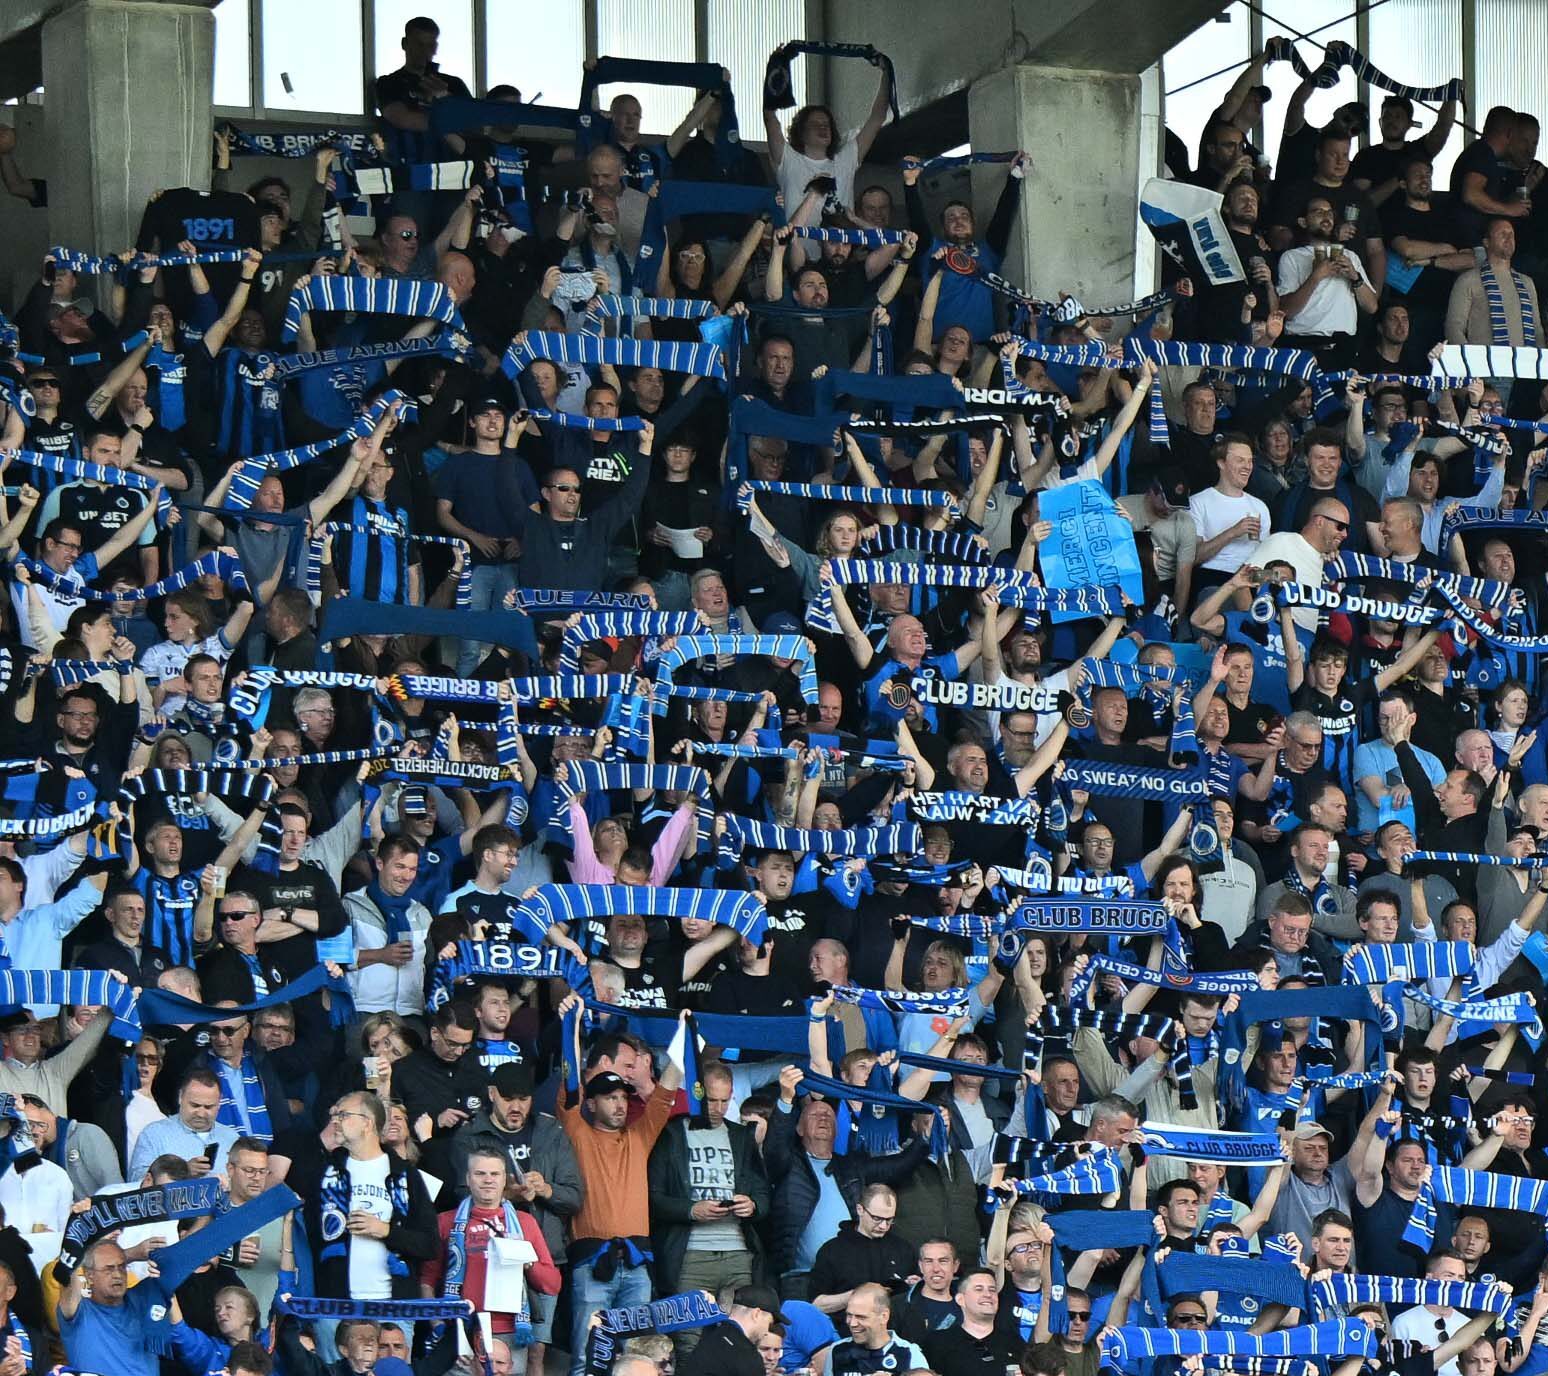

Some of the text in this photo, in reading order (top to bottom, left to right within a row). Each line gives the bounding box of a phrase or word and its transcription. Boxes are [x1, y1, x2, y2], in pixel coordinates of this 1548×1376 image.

[184, 218, 234, 240] 1891
[1284, 582, 1437, 624] CLUB BRUGGE
[473, 944, 560, 972] 1891
